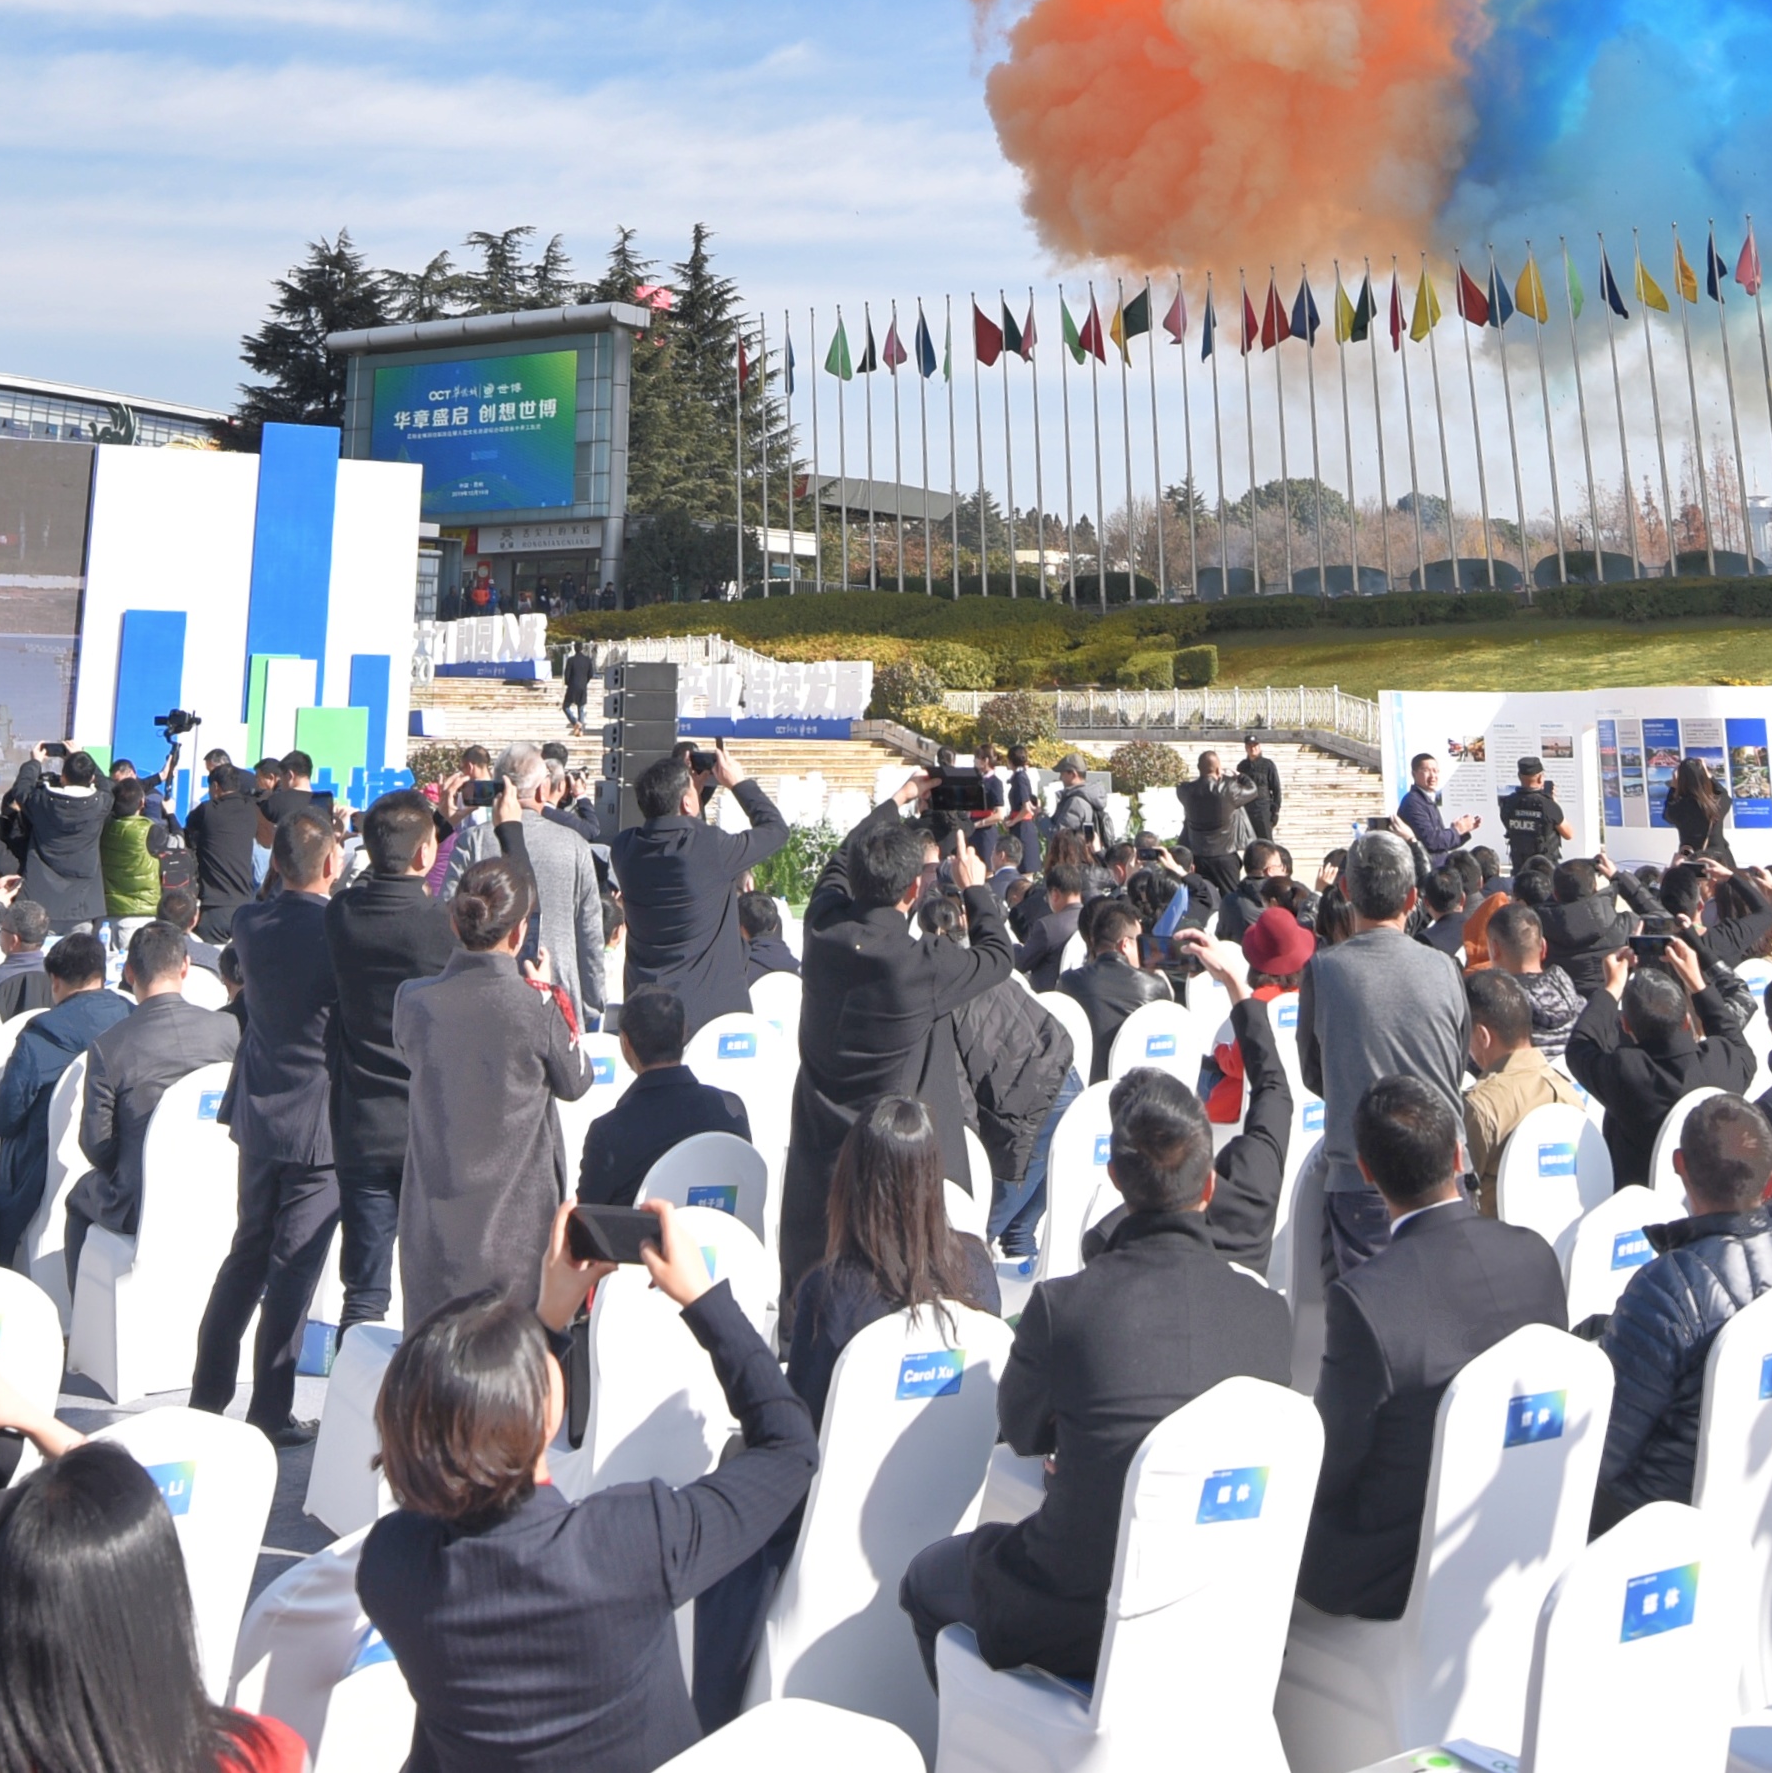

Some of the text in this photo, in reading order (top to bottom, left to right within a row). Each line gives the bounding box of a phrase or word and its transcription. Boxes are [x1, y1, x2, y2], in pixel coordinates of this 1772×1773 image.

[393, 398, 558, 430] 华章盛启 创想世博
[1509, 819, 1535, 831] POLICE
[903, 1366, 954, 1384] Carol Xu
